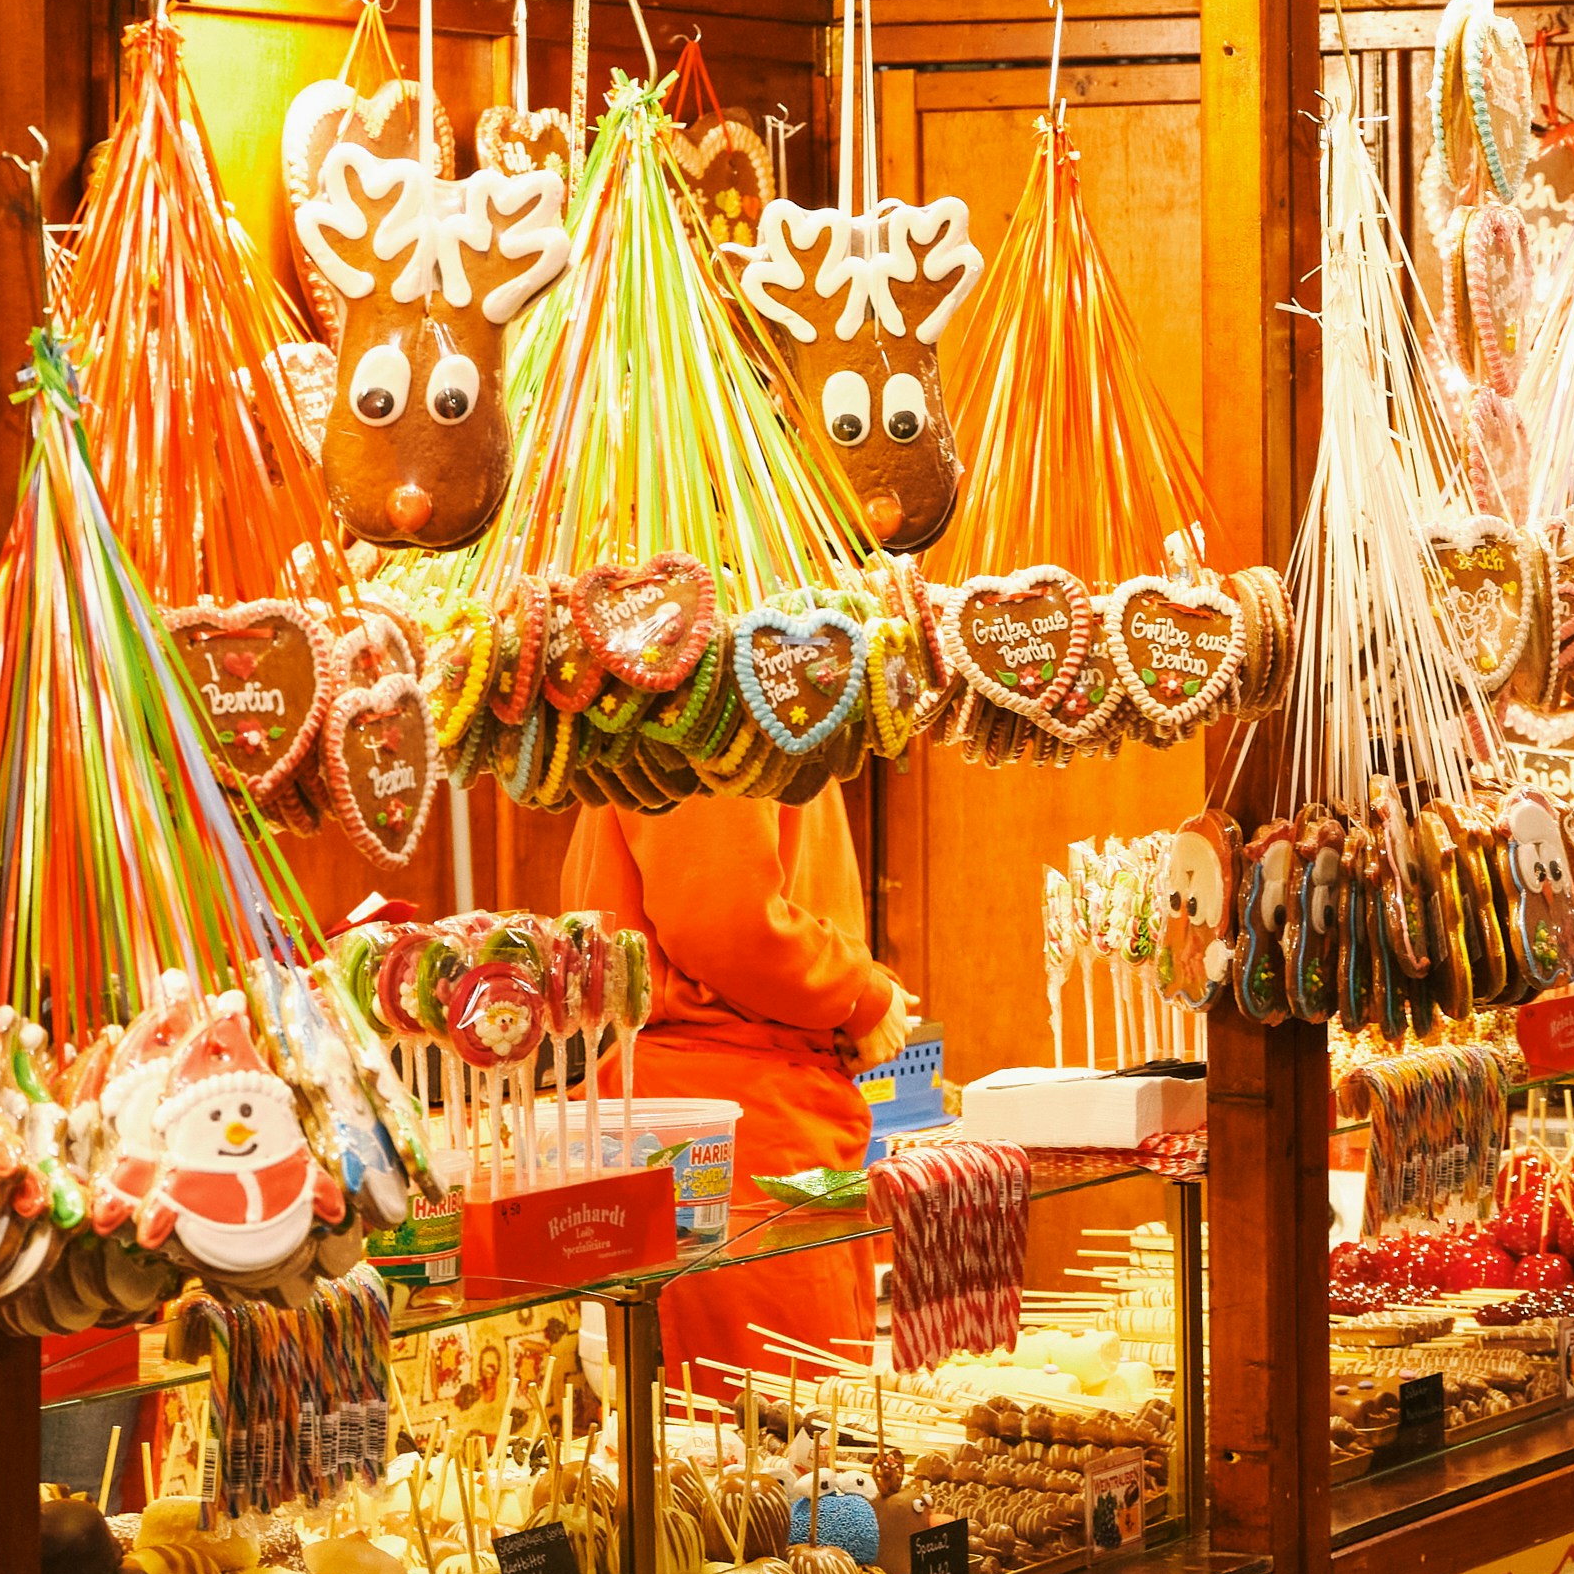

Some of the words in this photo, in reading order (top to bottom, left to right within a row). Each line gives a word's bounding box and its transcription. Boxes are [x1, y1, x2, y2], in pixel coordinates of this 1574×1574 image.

[972, 613, 1032, 646] Grüße
[1032, 610, 1070, 636] aus
[1130, 611, 1192, 653] Grüße
[1195, 632, 1231, 653] aus
[996, 637, 1058, 670] Berlin
[1148, 643, 1209, 678] Berlin
[200, 680, 284, 717] Berlin
[760, 670, 801, 709] Fest
[367, 755, 417, 801] Berlin
[547, 1202, 626, 1241] Reinhardt
